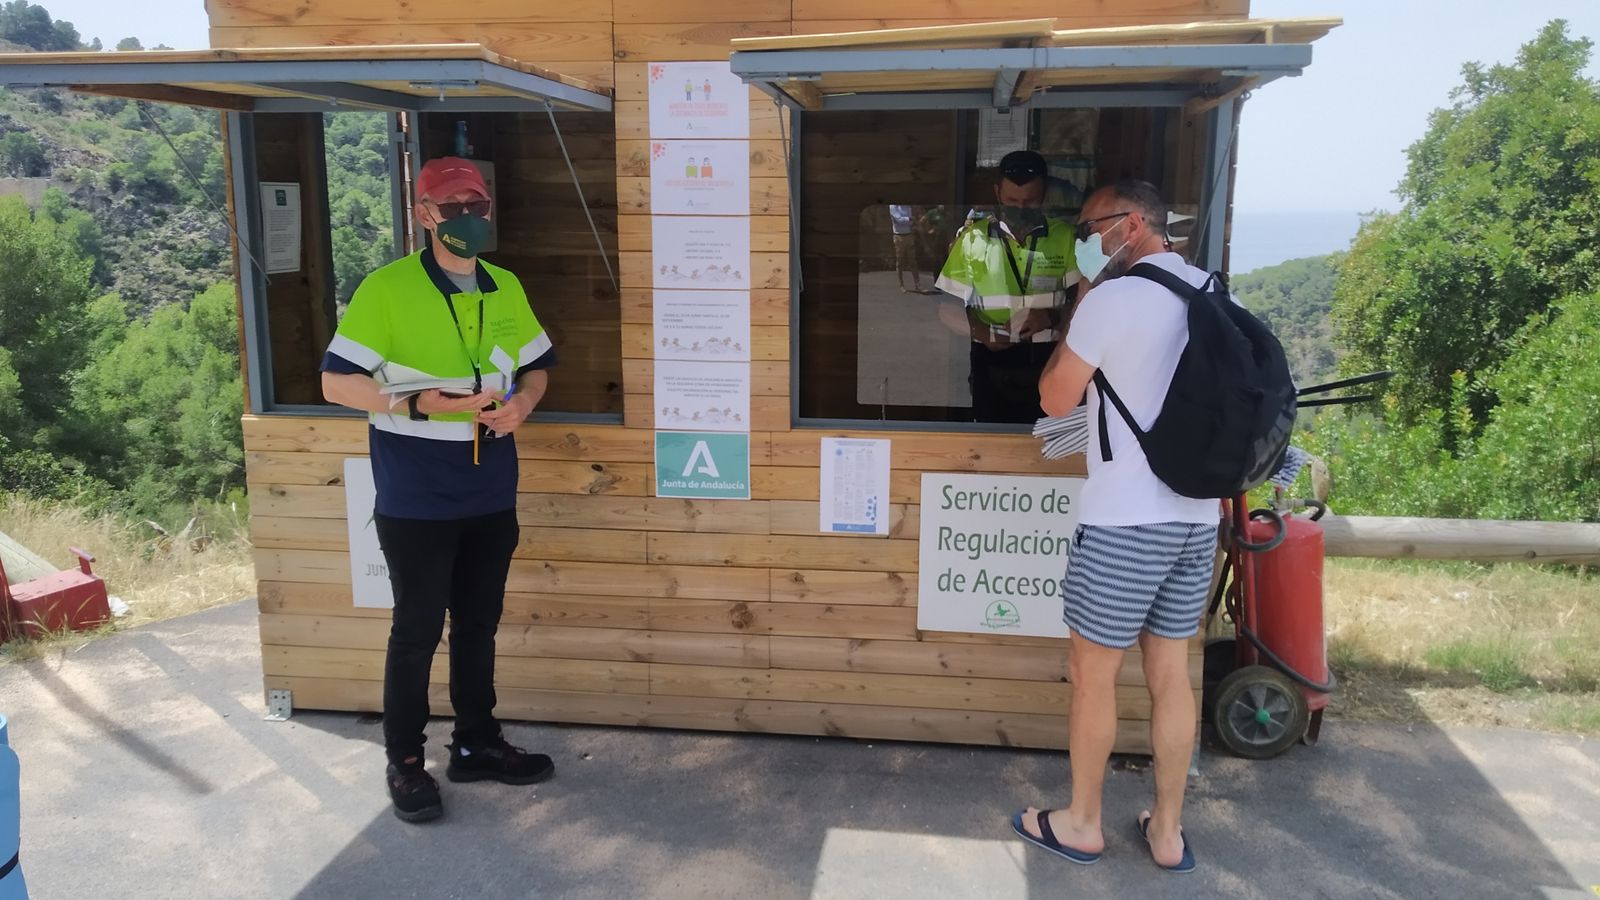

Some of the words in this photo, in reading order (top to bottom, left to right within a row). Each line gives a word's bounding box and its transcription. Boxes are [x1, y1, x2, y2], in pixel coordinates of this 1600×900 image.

[661, 480, 687, 488] Junta
[688, 480, 699, 488] de
[700, 481, 745, 490] Andalucía
[941, 485, 1033, 512] Servicio
[1040, 489, 1071, 514] de
[938, 526, 1070, 560] Regulación
[937, 568, 966, 592] de
[972, 569, 1065, 598] Accesos
